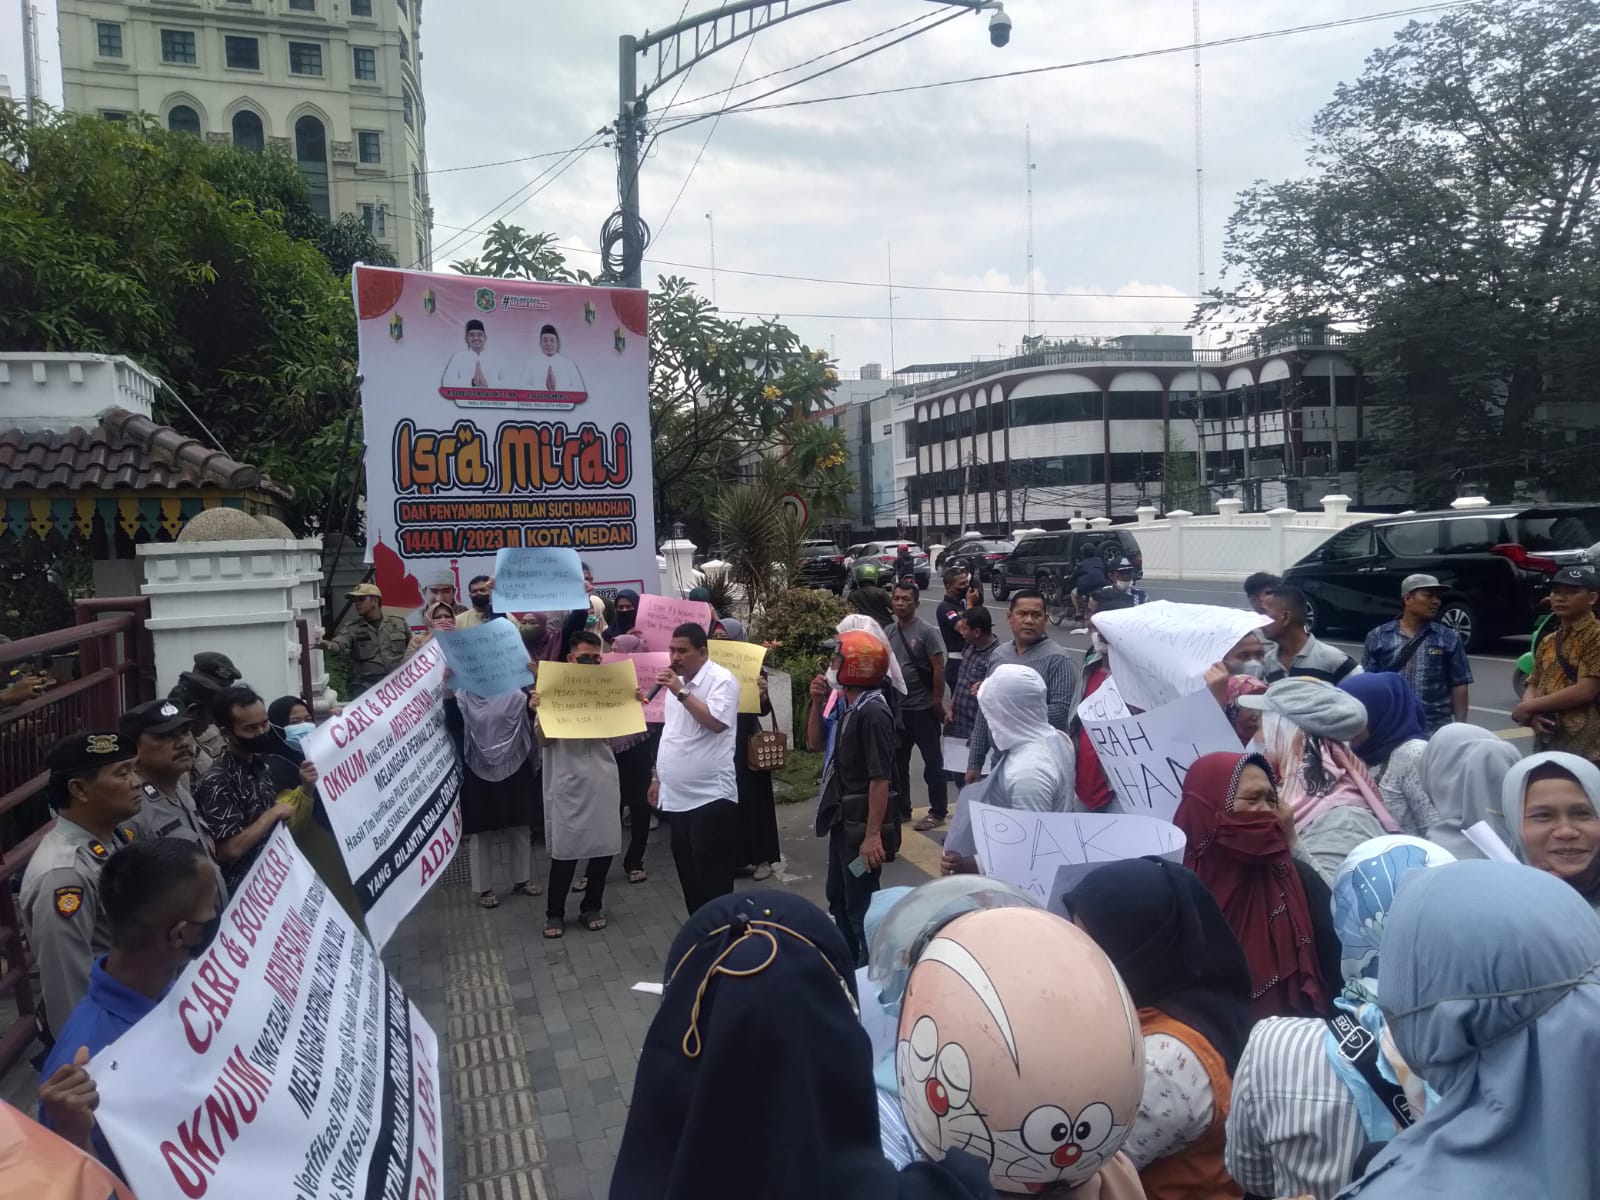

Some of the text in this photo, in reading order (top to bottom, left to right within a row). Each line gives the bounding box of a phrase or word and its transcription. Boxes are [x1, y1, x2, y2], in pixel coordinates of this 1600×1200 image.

[401, 500, 631, 521] DAN PENYAMBUTAN BULAN SUCI RAMADHAN
[404, 526, 631, 551] 1444 H / 2023 M KOTA MEDAN
[329, 706, 375, 749] CARI
[365, 698, 384, 717] &
[375, 653, 435, 709] BONGKAR
[322, 749, 369, 802] OKNUM
[389, 688, 435, 743] MENYESATKAN
[374, 745, 410, 793] MELANGGAR
[344, 827, 367, 852] Hasil
[362, 816, 377, 836] Tim
[366, 864, 392, 897] YANG
[393, 831, 426, 869] DILANTIK
[421, 802, 446, 833] ADALAH
[421, 827, 455, 887] ADA
[230, 848, 291, 949] BONGKAR
[219, 931, 250, 970] &
[263, 905, 314, 1010] MENYESATKAN
[178, 947, 240, 1055] CARI
[266, 994, 292, 1045] TELAH
[306, 975, 334, 1031] PERWAL
[249, 1027, 279, 1076] YANG
[287, 1014, 327, 1120] MELANGGAR
[389, 1028, 409, 1099] ORANG
[159, 1044, 272, 1200] OKNUM
[293, 1107, 343, 1199] Verifikasi
[330, 1066, 353, 1122] PILKEP
[391, 1089, 409, 1168] ADALAH
[416, 1060, 437, 1156] APA
[331, 1114, 370, 1200] SYAMSUL
